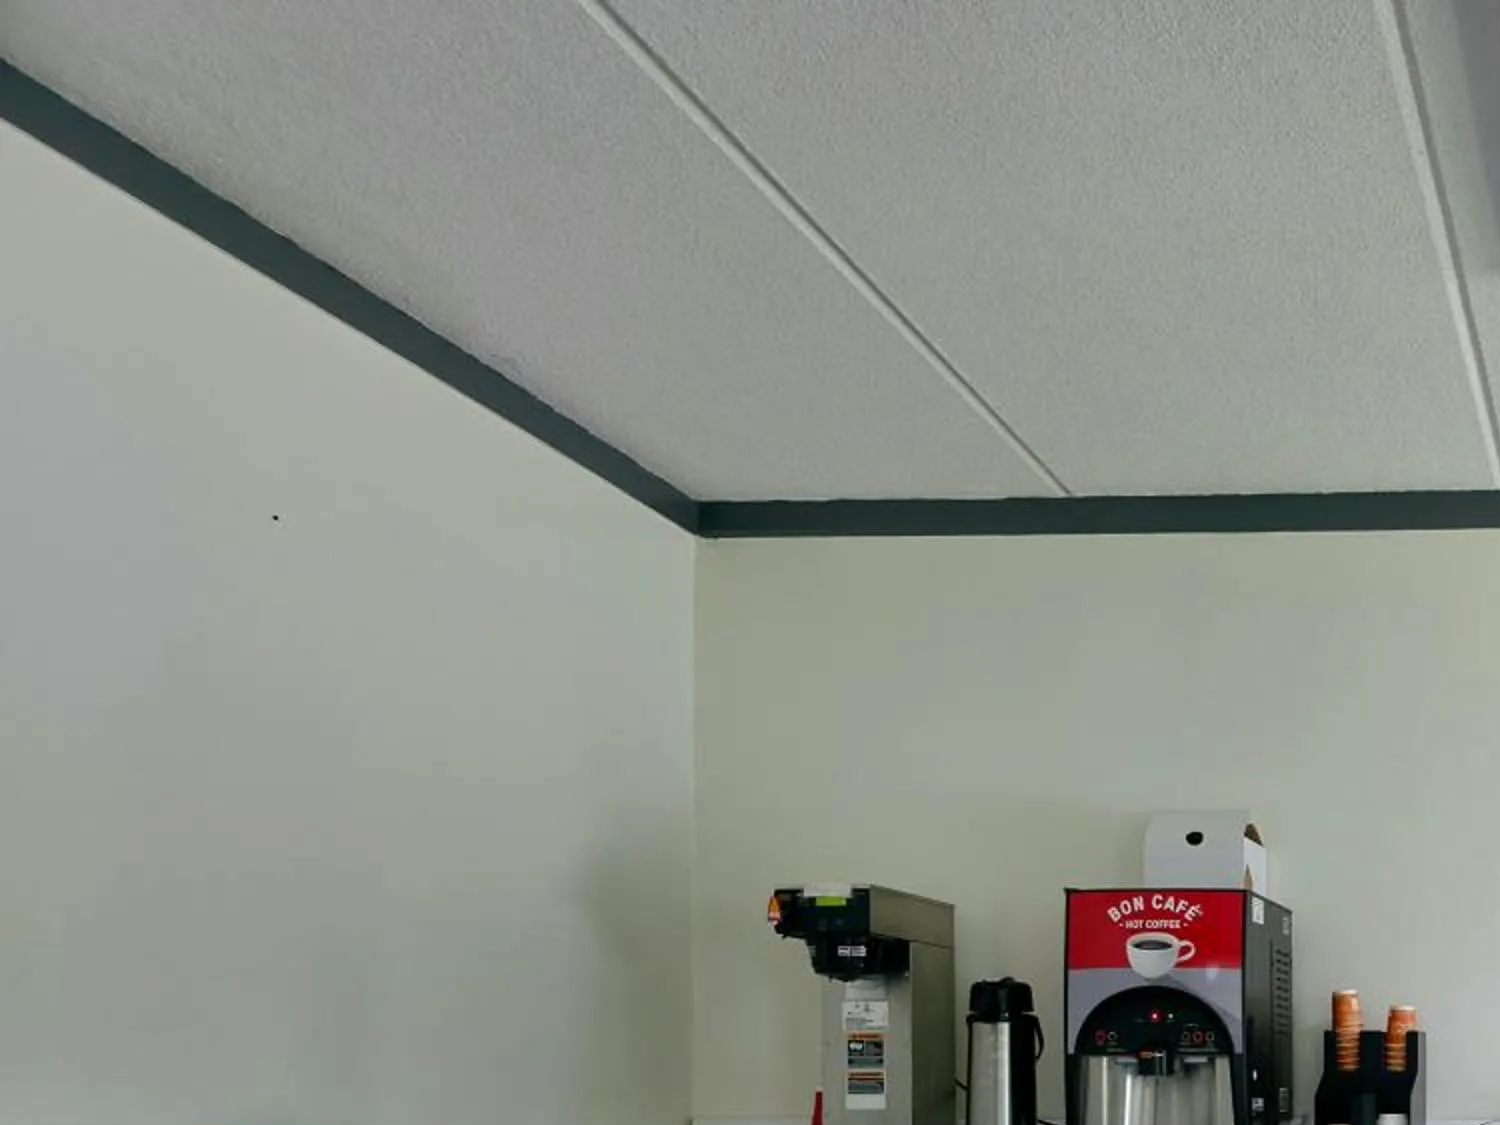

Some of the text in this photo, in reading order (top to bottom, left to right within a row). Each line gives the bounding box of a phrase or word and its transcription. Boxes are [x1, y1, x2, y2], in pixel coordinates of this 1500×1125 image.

[1107, 894, 1202, 922] BON CAFÉ
[1125, 919, 1182, 929] HOT COFFEE
